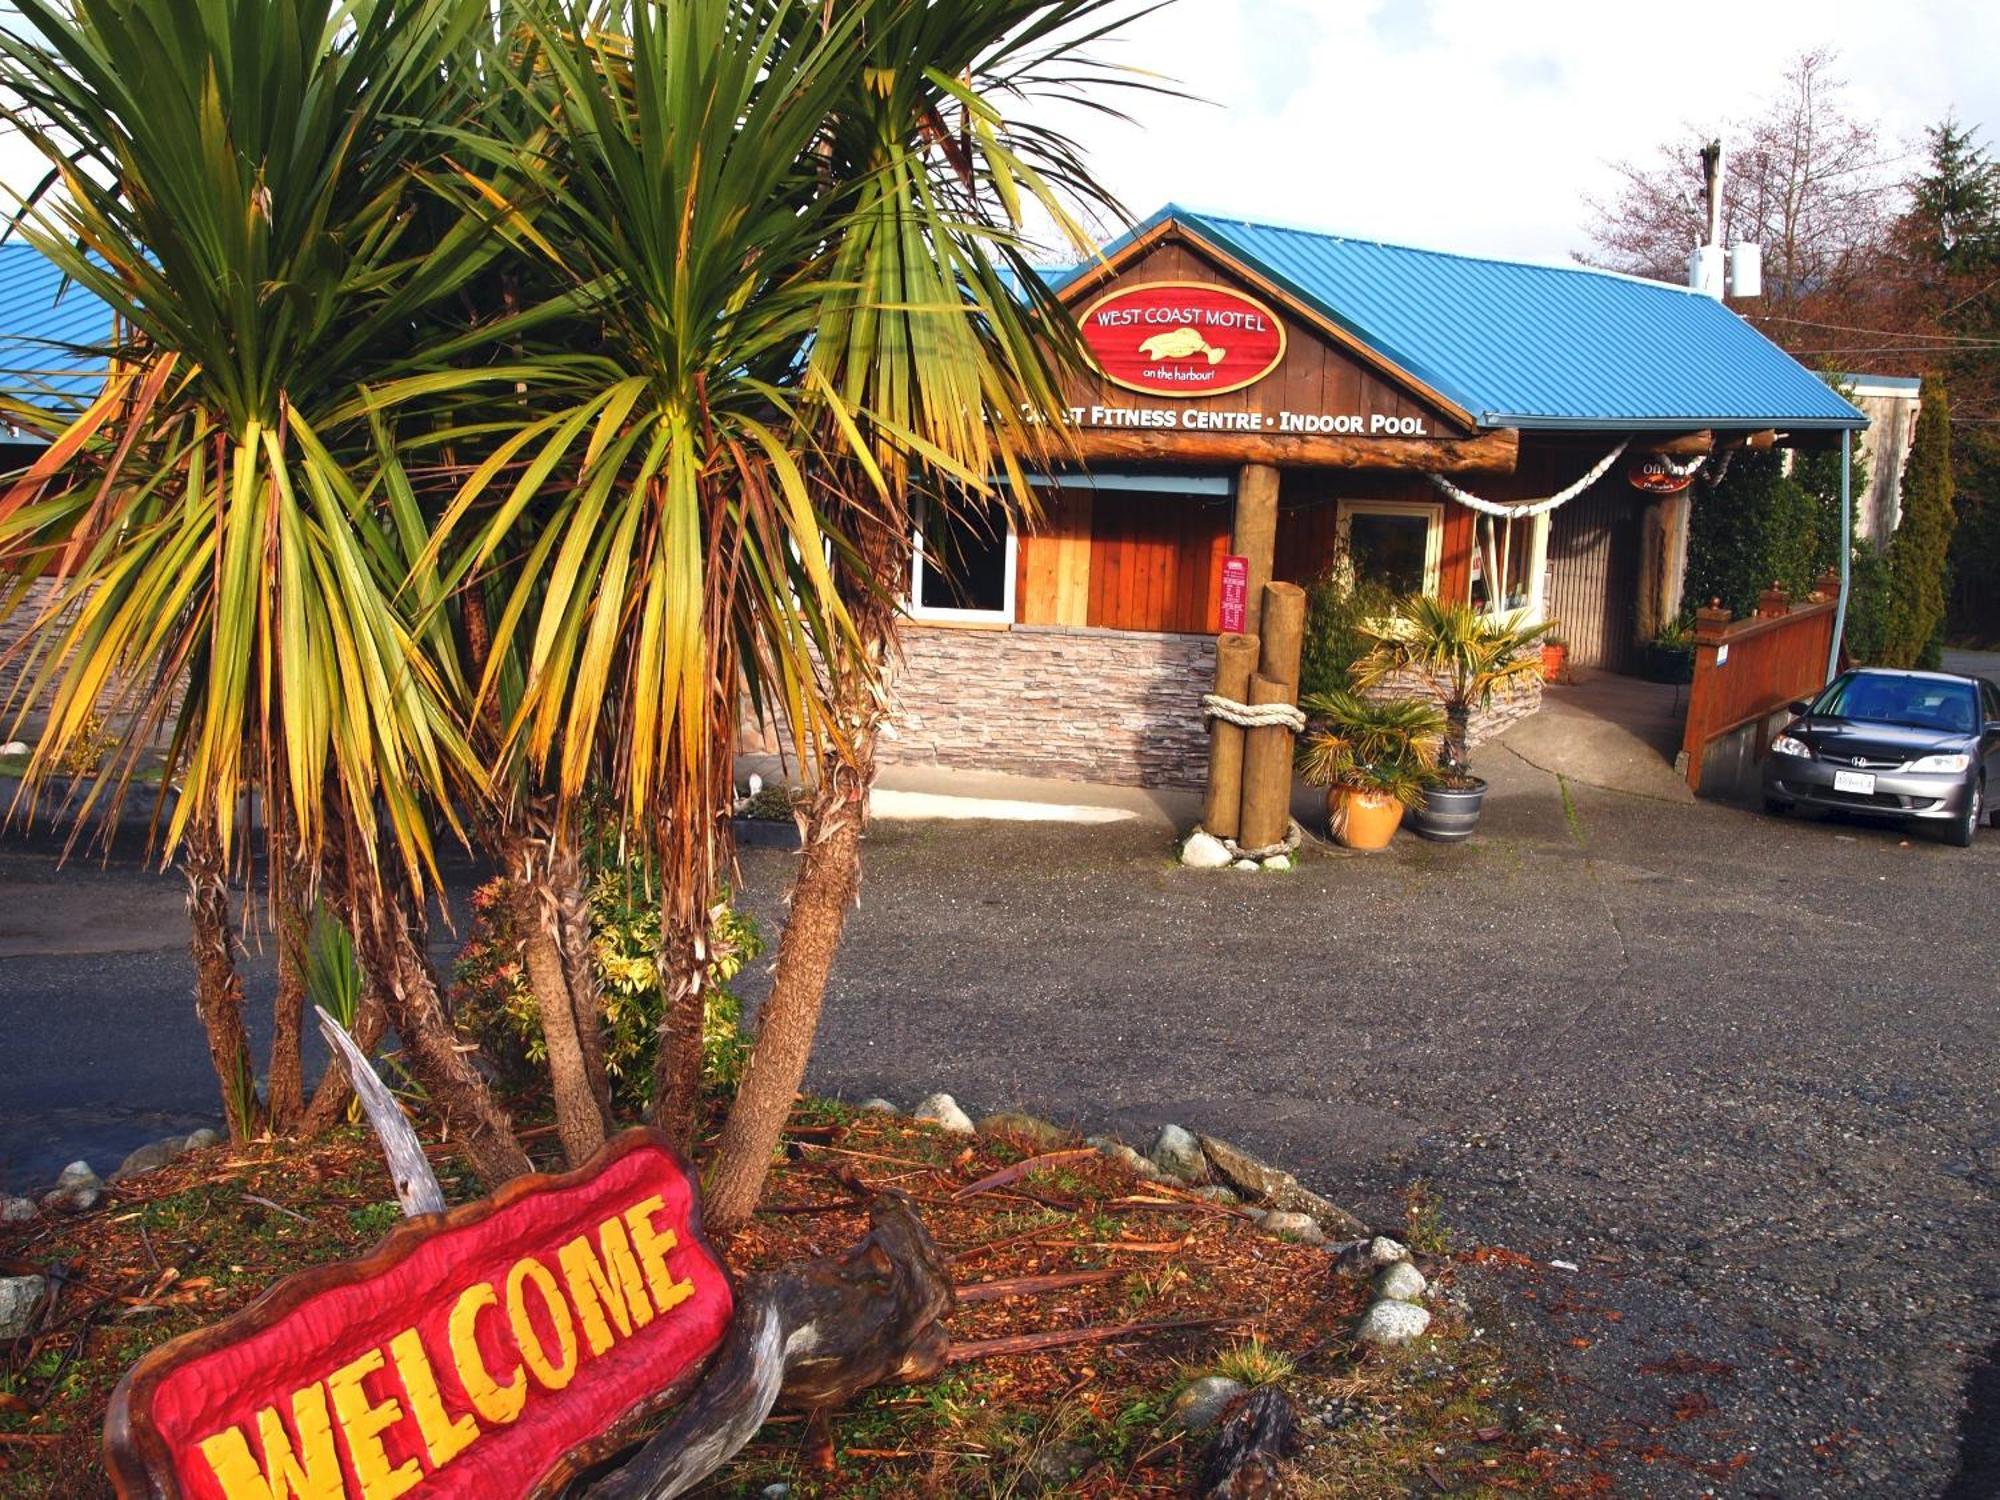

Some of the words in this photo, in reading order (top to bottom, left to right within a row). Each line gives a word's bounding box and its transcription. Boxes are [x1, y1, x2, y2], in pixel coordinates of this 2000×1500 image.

[1098, 310, 1142, 326] WEST
[1145, 307, 1202, 324] COAST
[1205, 309, 1266, 332] MOTEL
[1157, 366, 1173, 380] the
[1091, 406, 1176, 427] FITNESS
[1182, 408, 1262, 430] CENTRE
[1279, 411, 1364, 433] INDOOR
[1370, 413, 1427, 435] POOL
[199, 1194, 695, 1500] WELCOME
